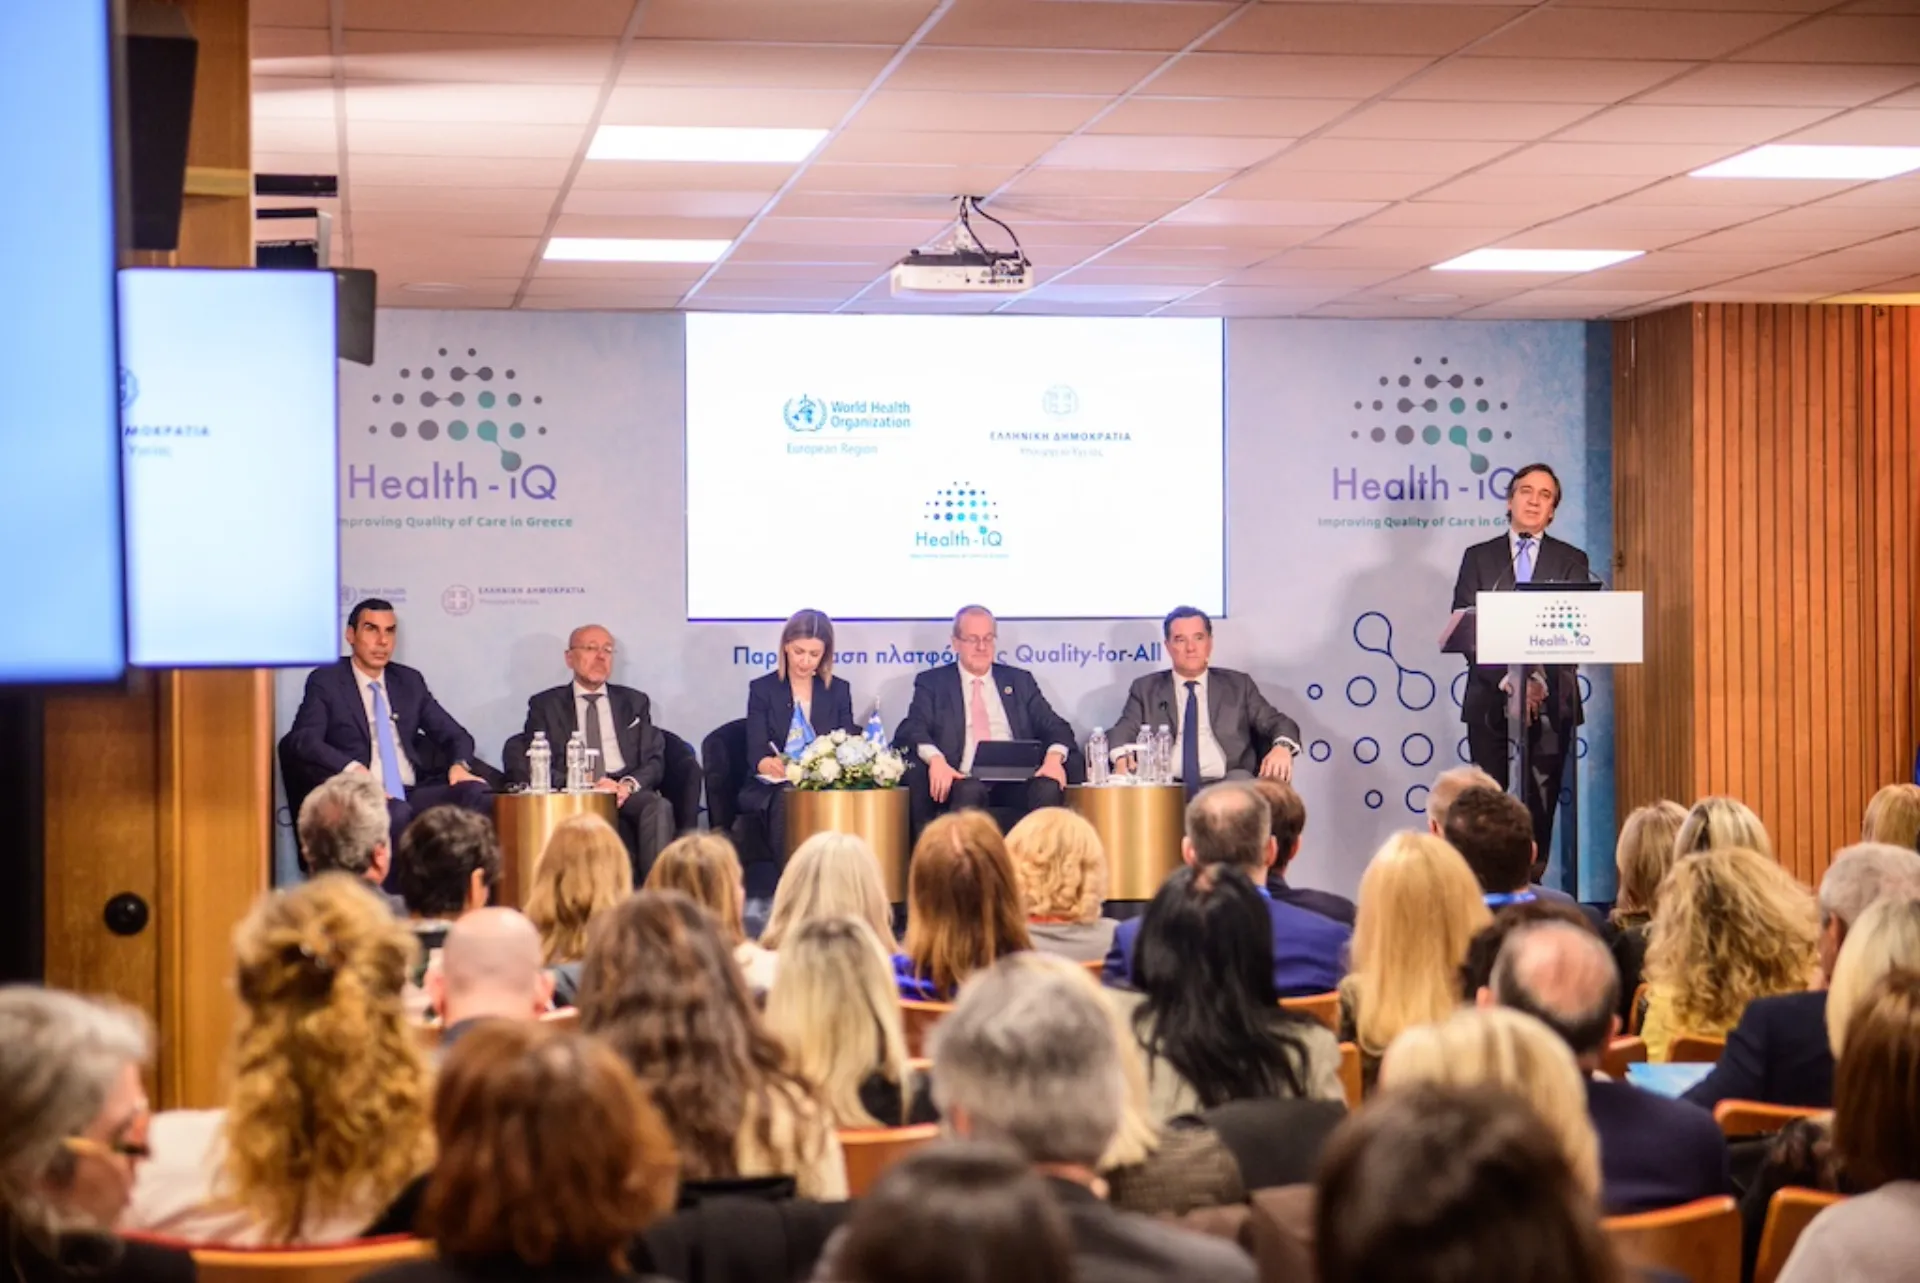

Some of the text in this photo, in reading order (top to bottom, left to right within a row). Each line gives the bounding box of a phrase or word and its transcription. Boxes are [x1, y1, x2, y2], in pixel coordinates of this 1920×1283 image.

[830, 401, 911, 414] World Health
[830, 415, 911, 431] Organization
[124, 425, 210, 437] ΜΟΚΡΑΤΙΑ
[1053, 431, 1131, 441] ΔΗΜΟΚΡΑΤΙΑ
[786, 442, 878, 457] European Region
[349, 461, 477, 500] Health
[1333, 464, 1449, 500] Health
[337, 516, 573, 529] mproving Quality of Care in Greece
[1318, 517, 1381, 529] Improving
[1384, 517, 1429, 529] Quality
[1431, 517, 1446, 527] of
[1449, 517, 1476, 527] Care
[1478, 517, 1491, 527] in
[915, 529, 970, 546] Health
[1529, 634, 1568, 646] Health
[734, 643, 1162, 670] Παραση πλατφός Quality-for-All
